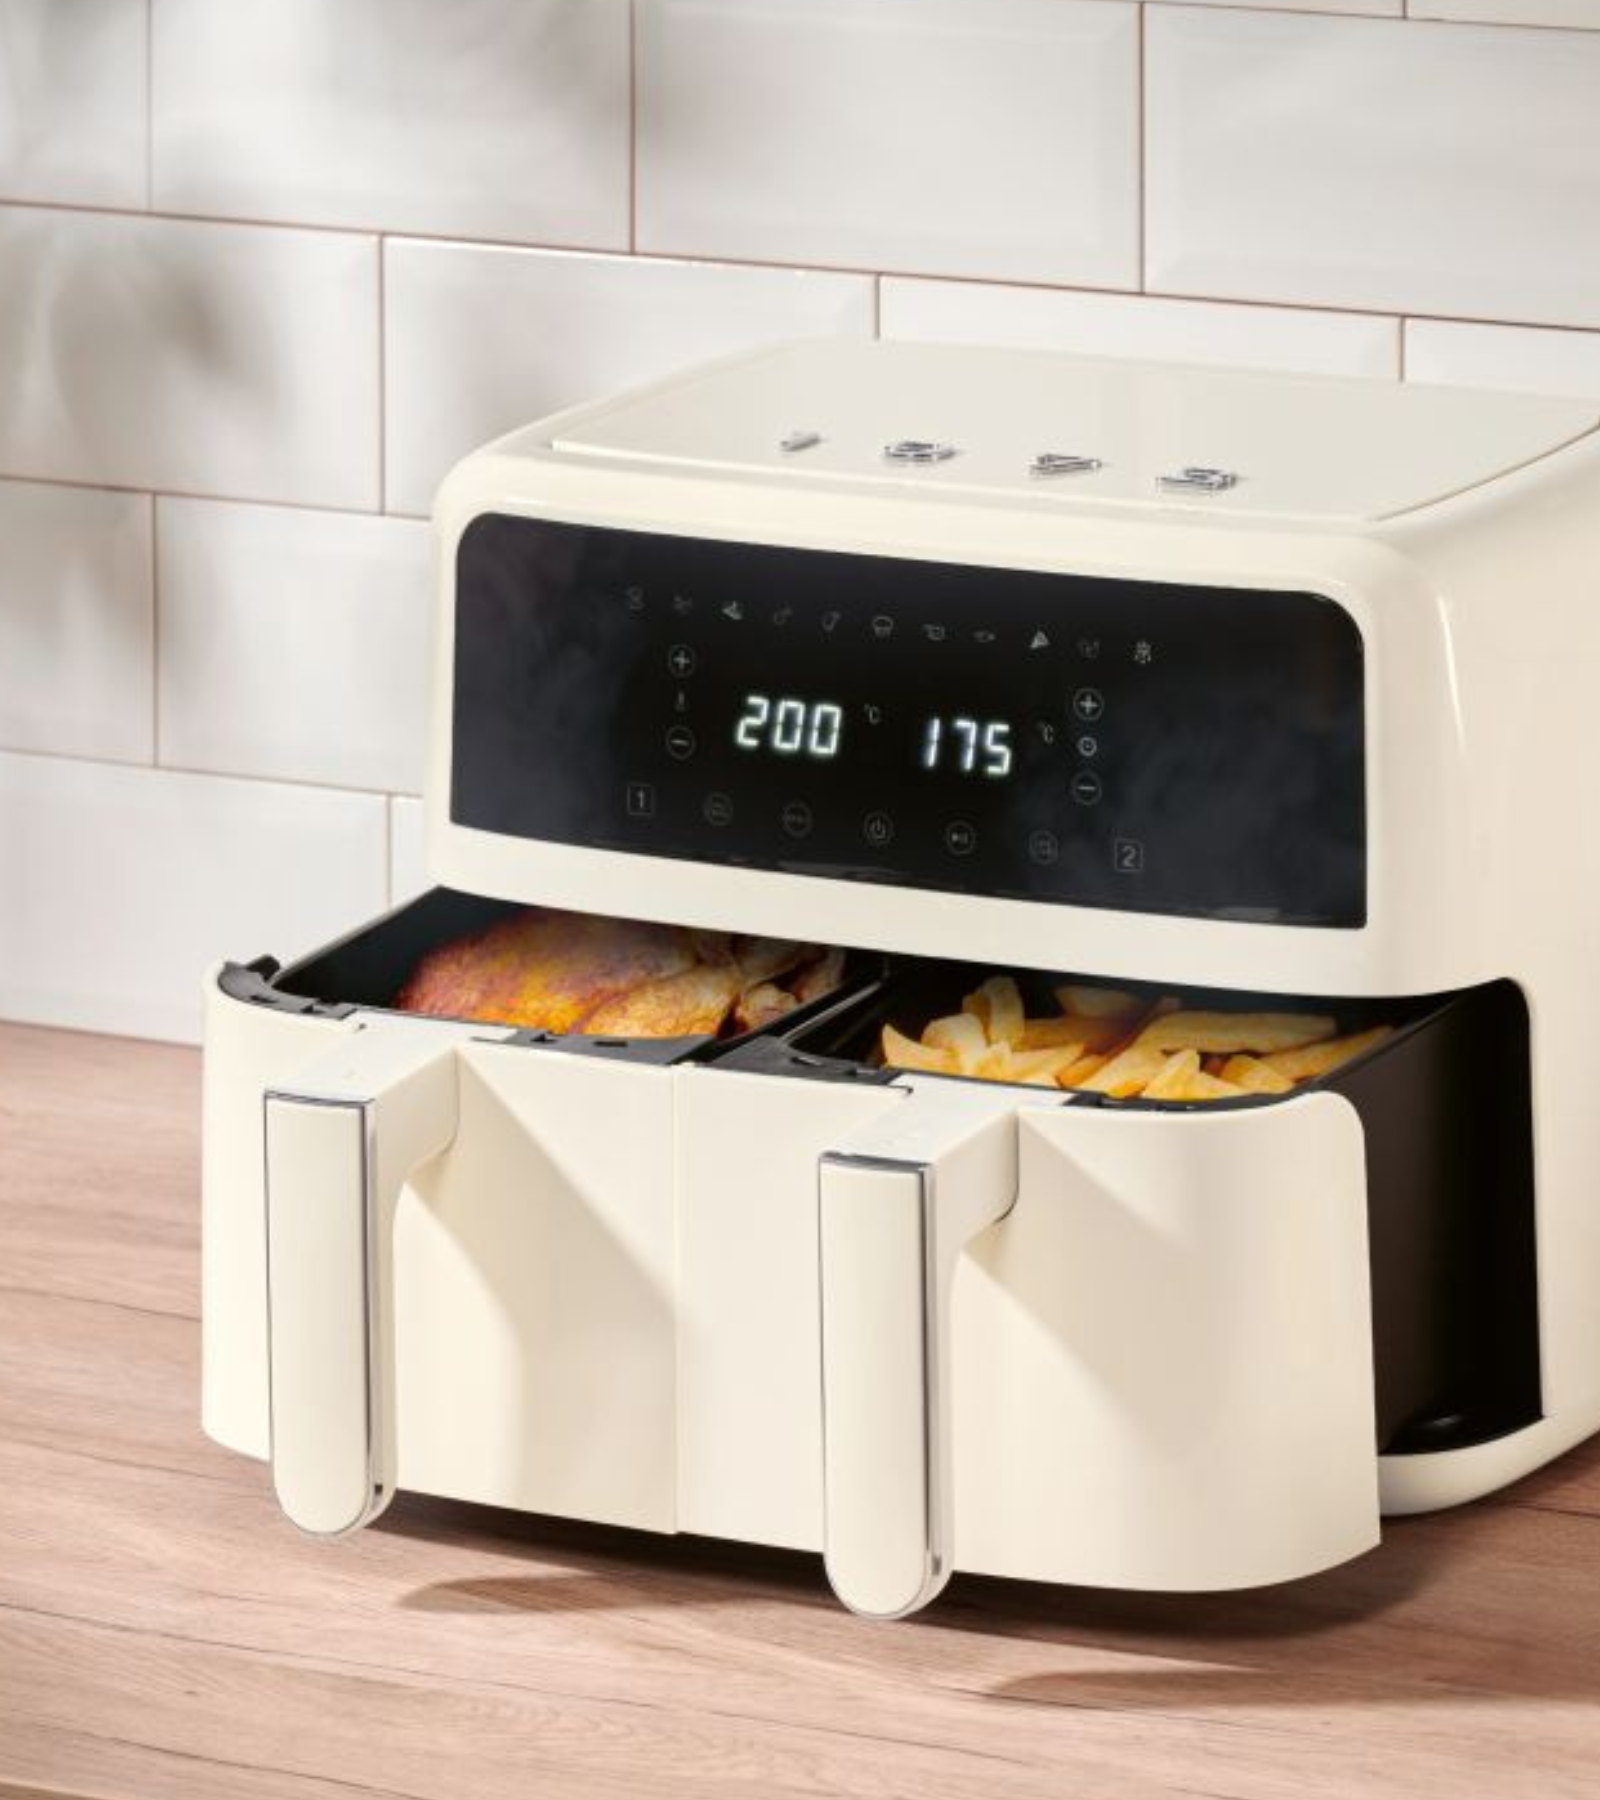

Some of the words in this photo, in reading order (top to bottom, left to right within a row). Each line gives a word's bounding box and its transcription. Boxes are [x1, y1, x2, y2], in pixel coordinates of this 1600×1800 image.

[735, 695, 842, 758] 200
[924, 717, 1013, 776] 175
[1121, 844, 1137, 868] 2
